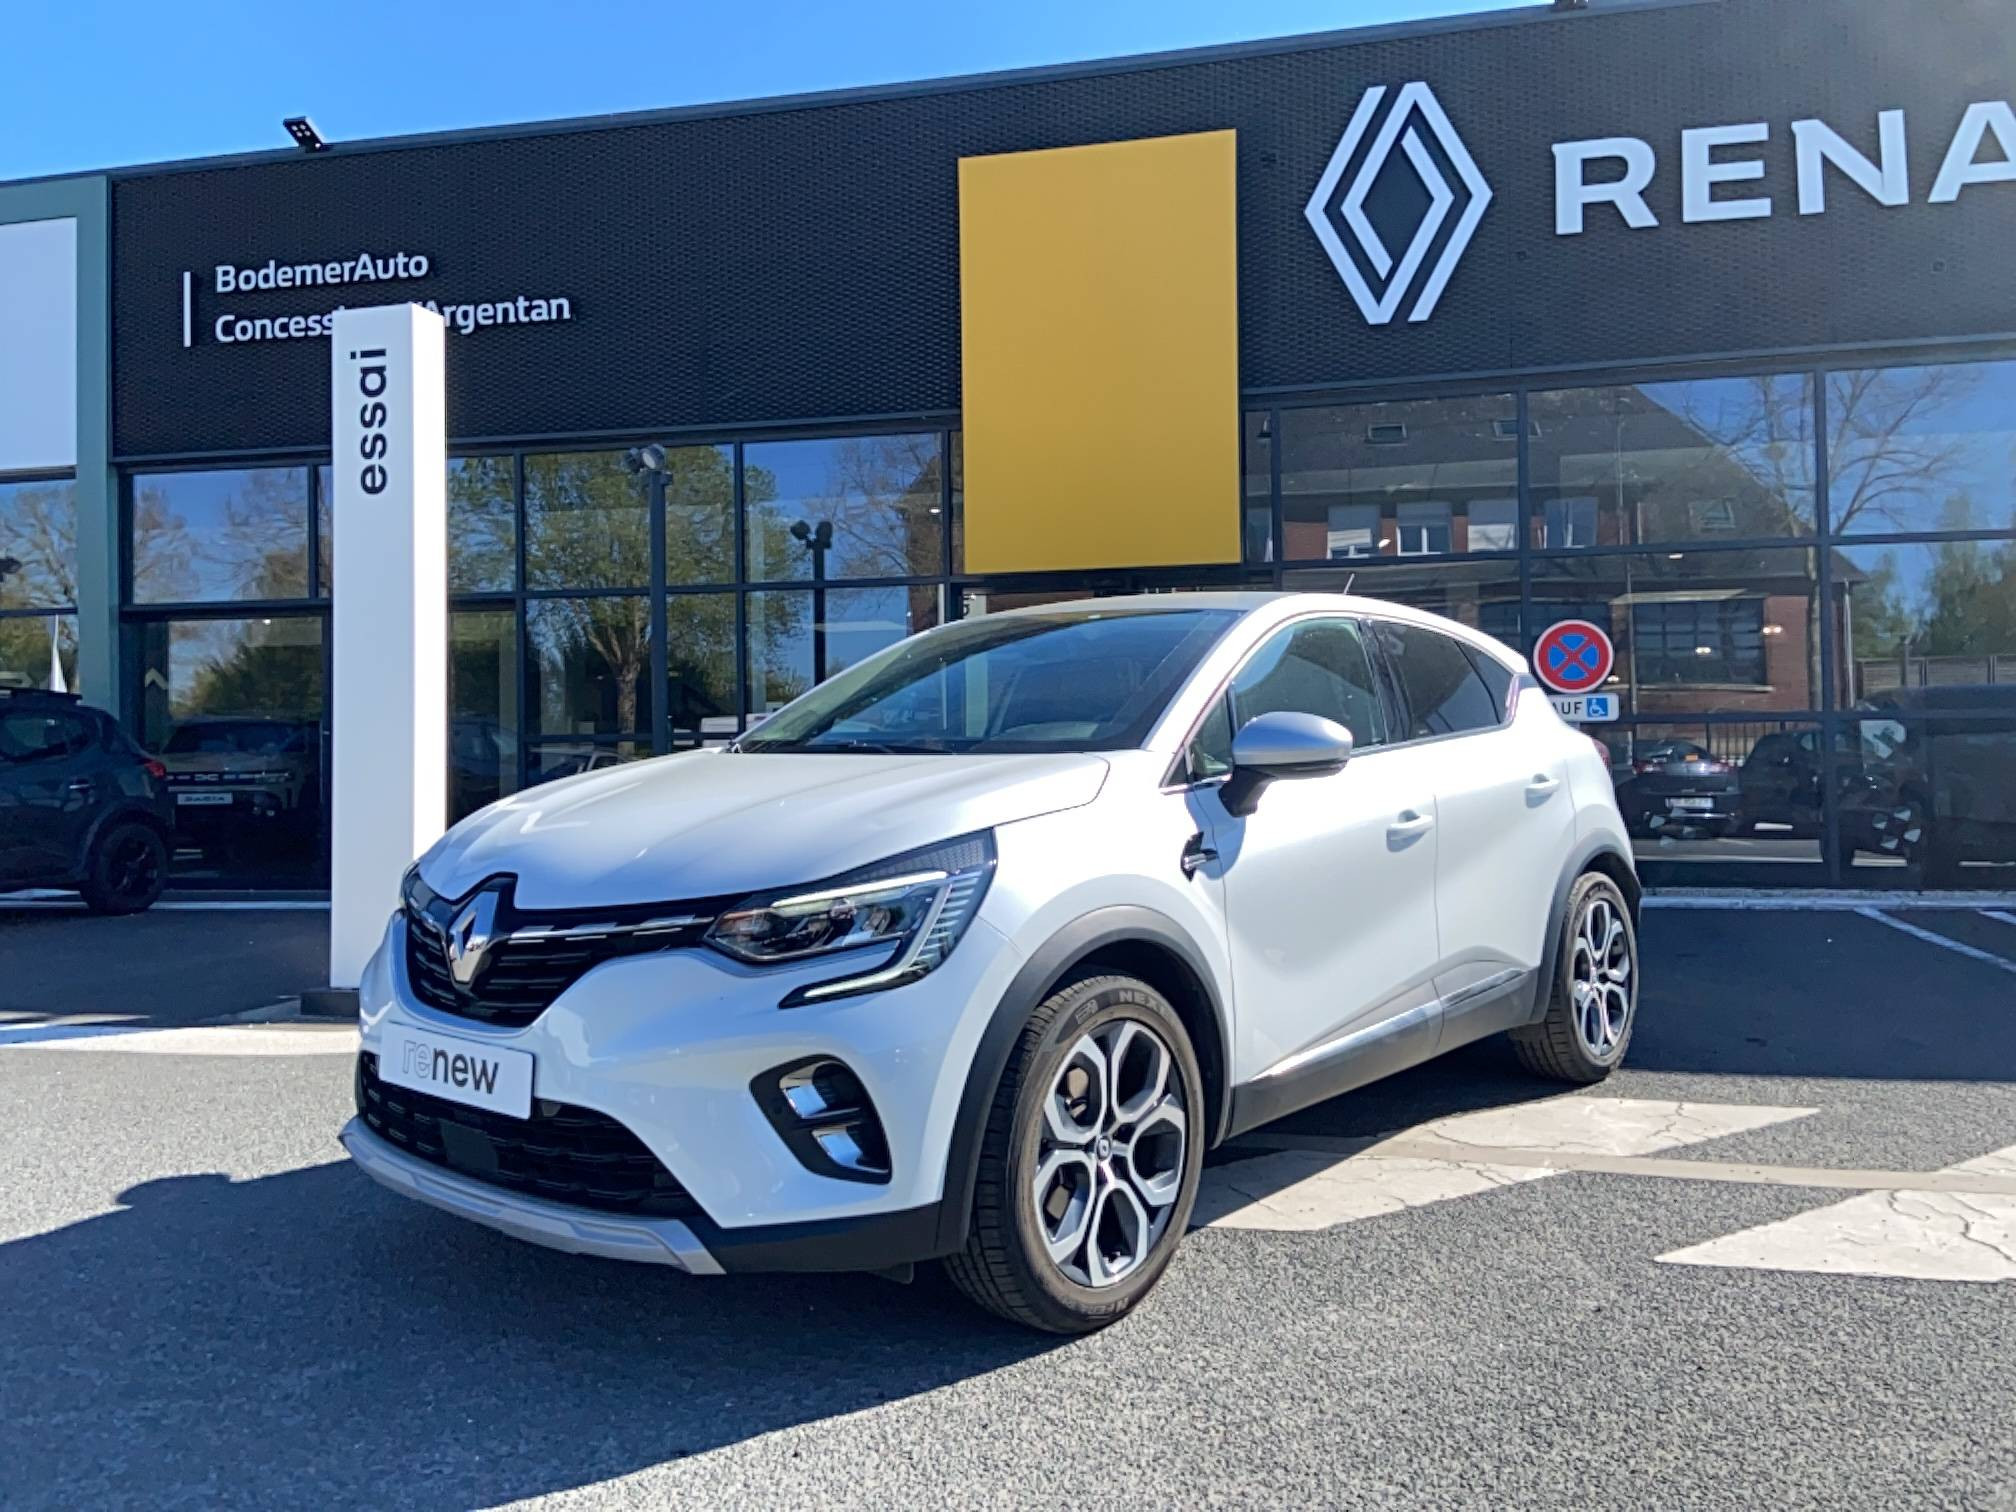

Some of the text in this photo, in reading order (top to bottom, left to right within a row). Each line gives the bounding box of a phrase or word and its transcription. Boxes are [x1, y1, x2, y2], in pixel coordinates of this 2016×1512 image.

[1551, 100, 2016, 237] RENA
[215, 251, 429, 294] BodemerAuto
[215, 305, 345, 343] Concess
[350, 348, 388, 496] essai
[402, 1039, 499, 1095] renew
